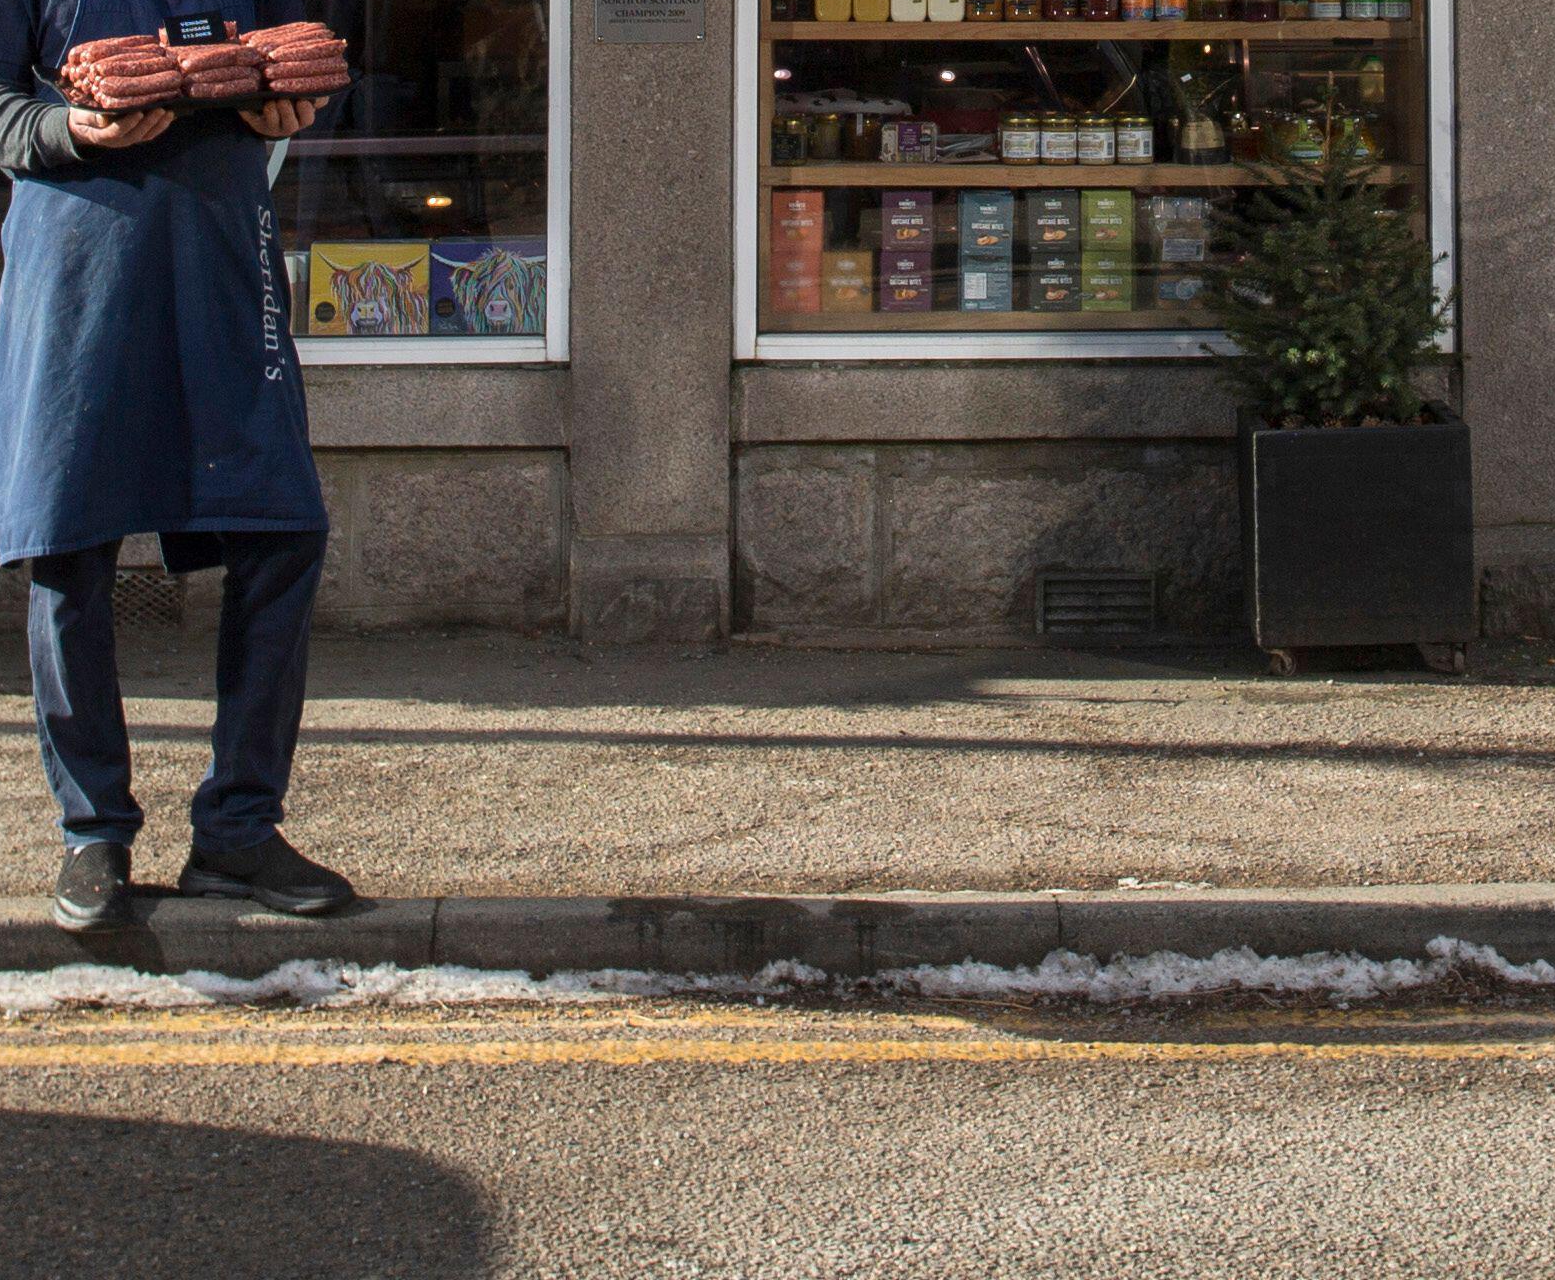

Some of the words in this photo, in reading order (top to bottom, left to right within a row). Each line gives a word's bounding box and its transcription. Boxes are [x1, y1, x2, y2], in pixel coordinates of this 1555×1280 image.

[615, 9, 666, 18] CHAMPION
[667, 9, 686, 18] 2009
[258, 205, 285, 382] Sheridan's
